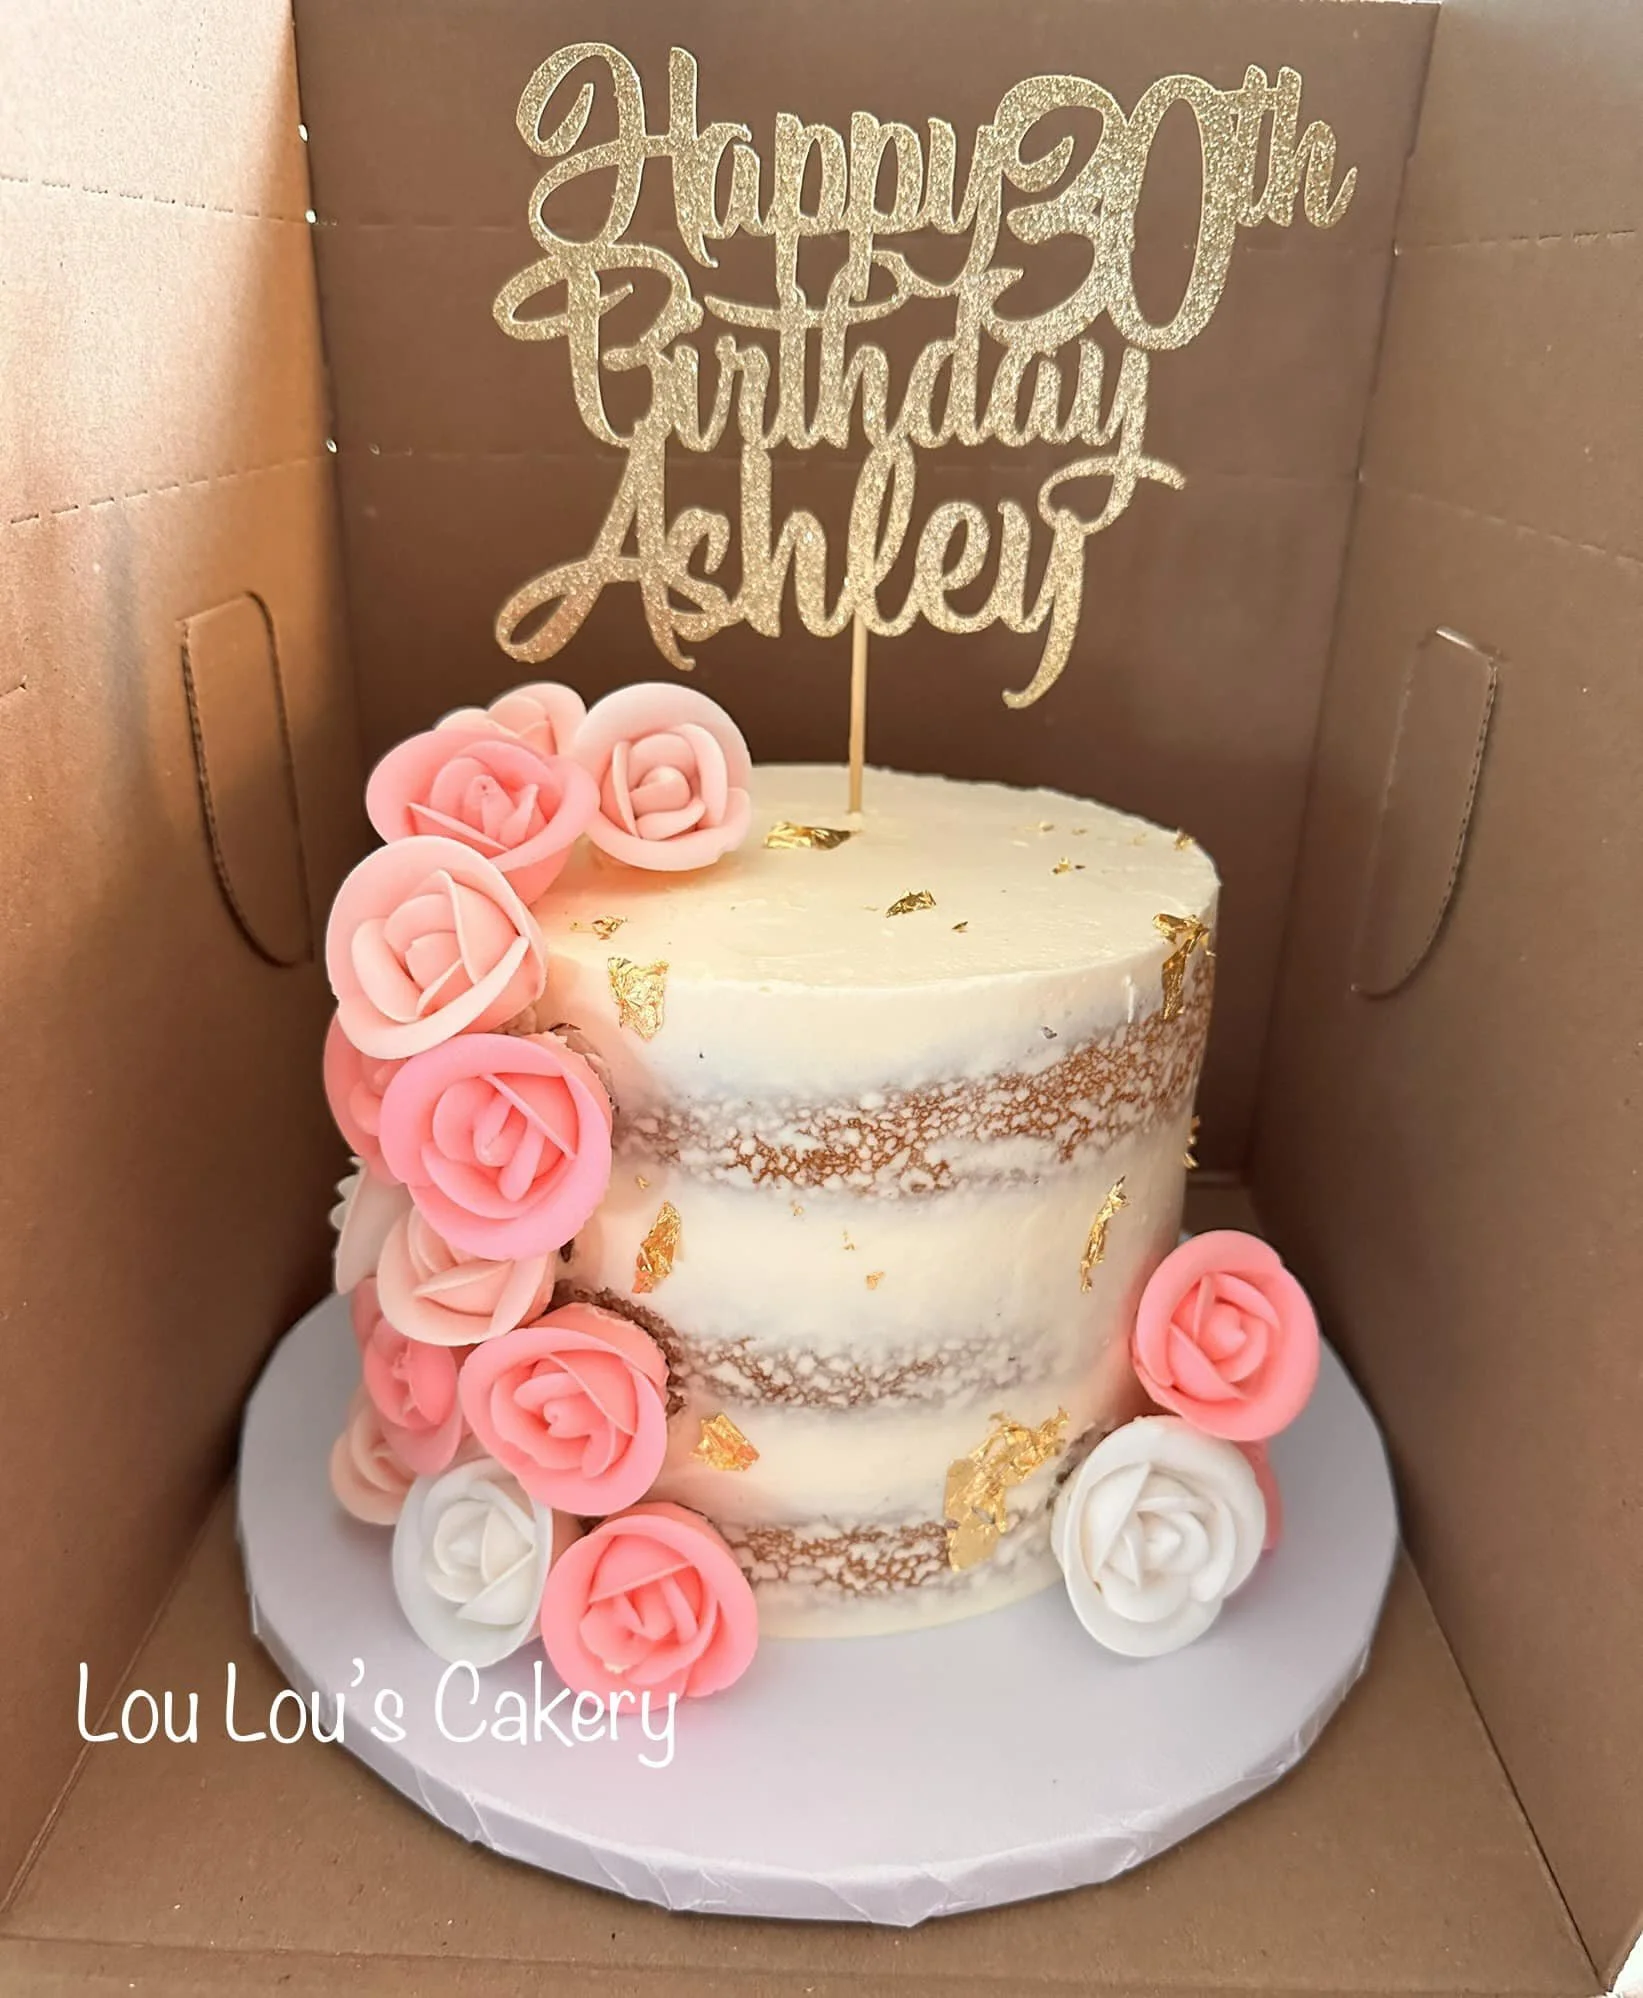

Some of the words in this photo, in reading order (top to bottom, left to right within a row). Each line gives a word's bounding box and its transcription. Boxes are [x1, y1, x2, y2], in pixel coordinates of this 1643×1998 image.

[516, 42, 1004, 297] Happy
[980, 65, 1358, 351] 30th
[492, 243, 1186, 535] Birthday
[494, 422, 1087, 709] Ashley
